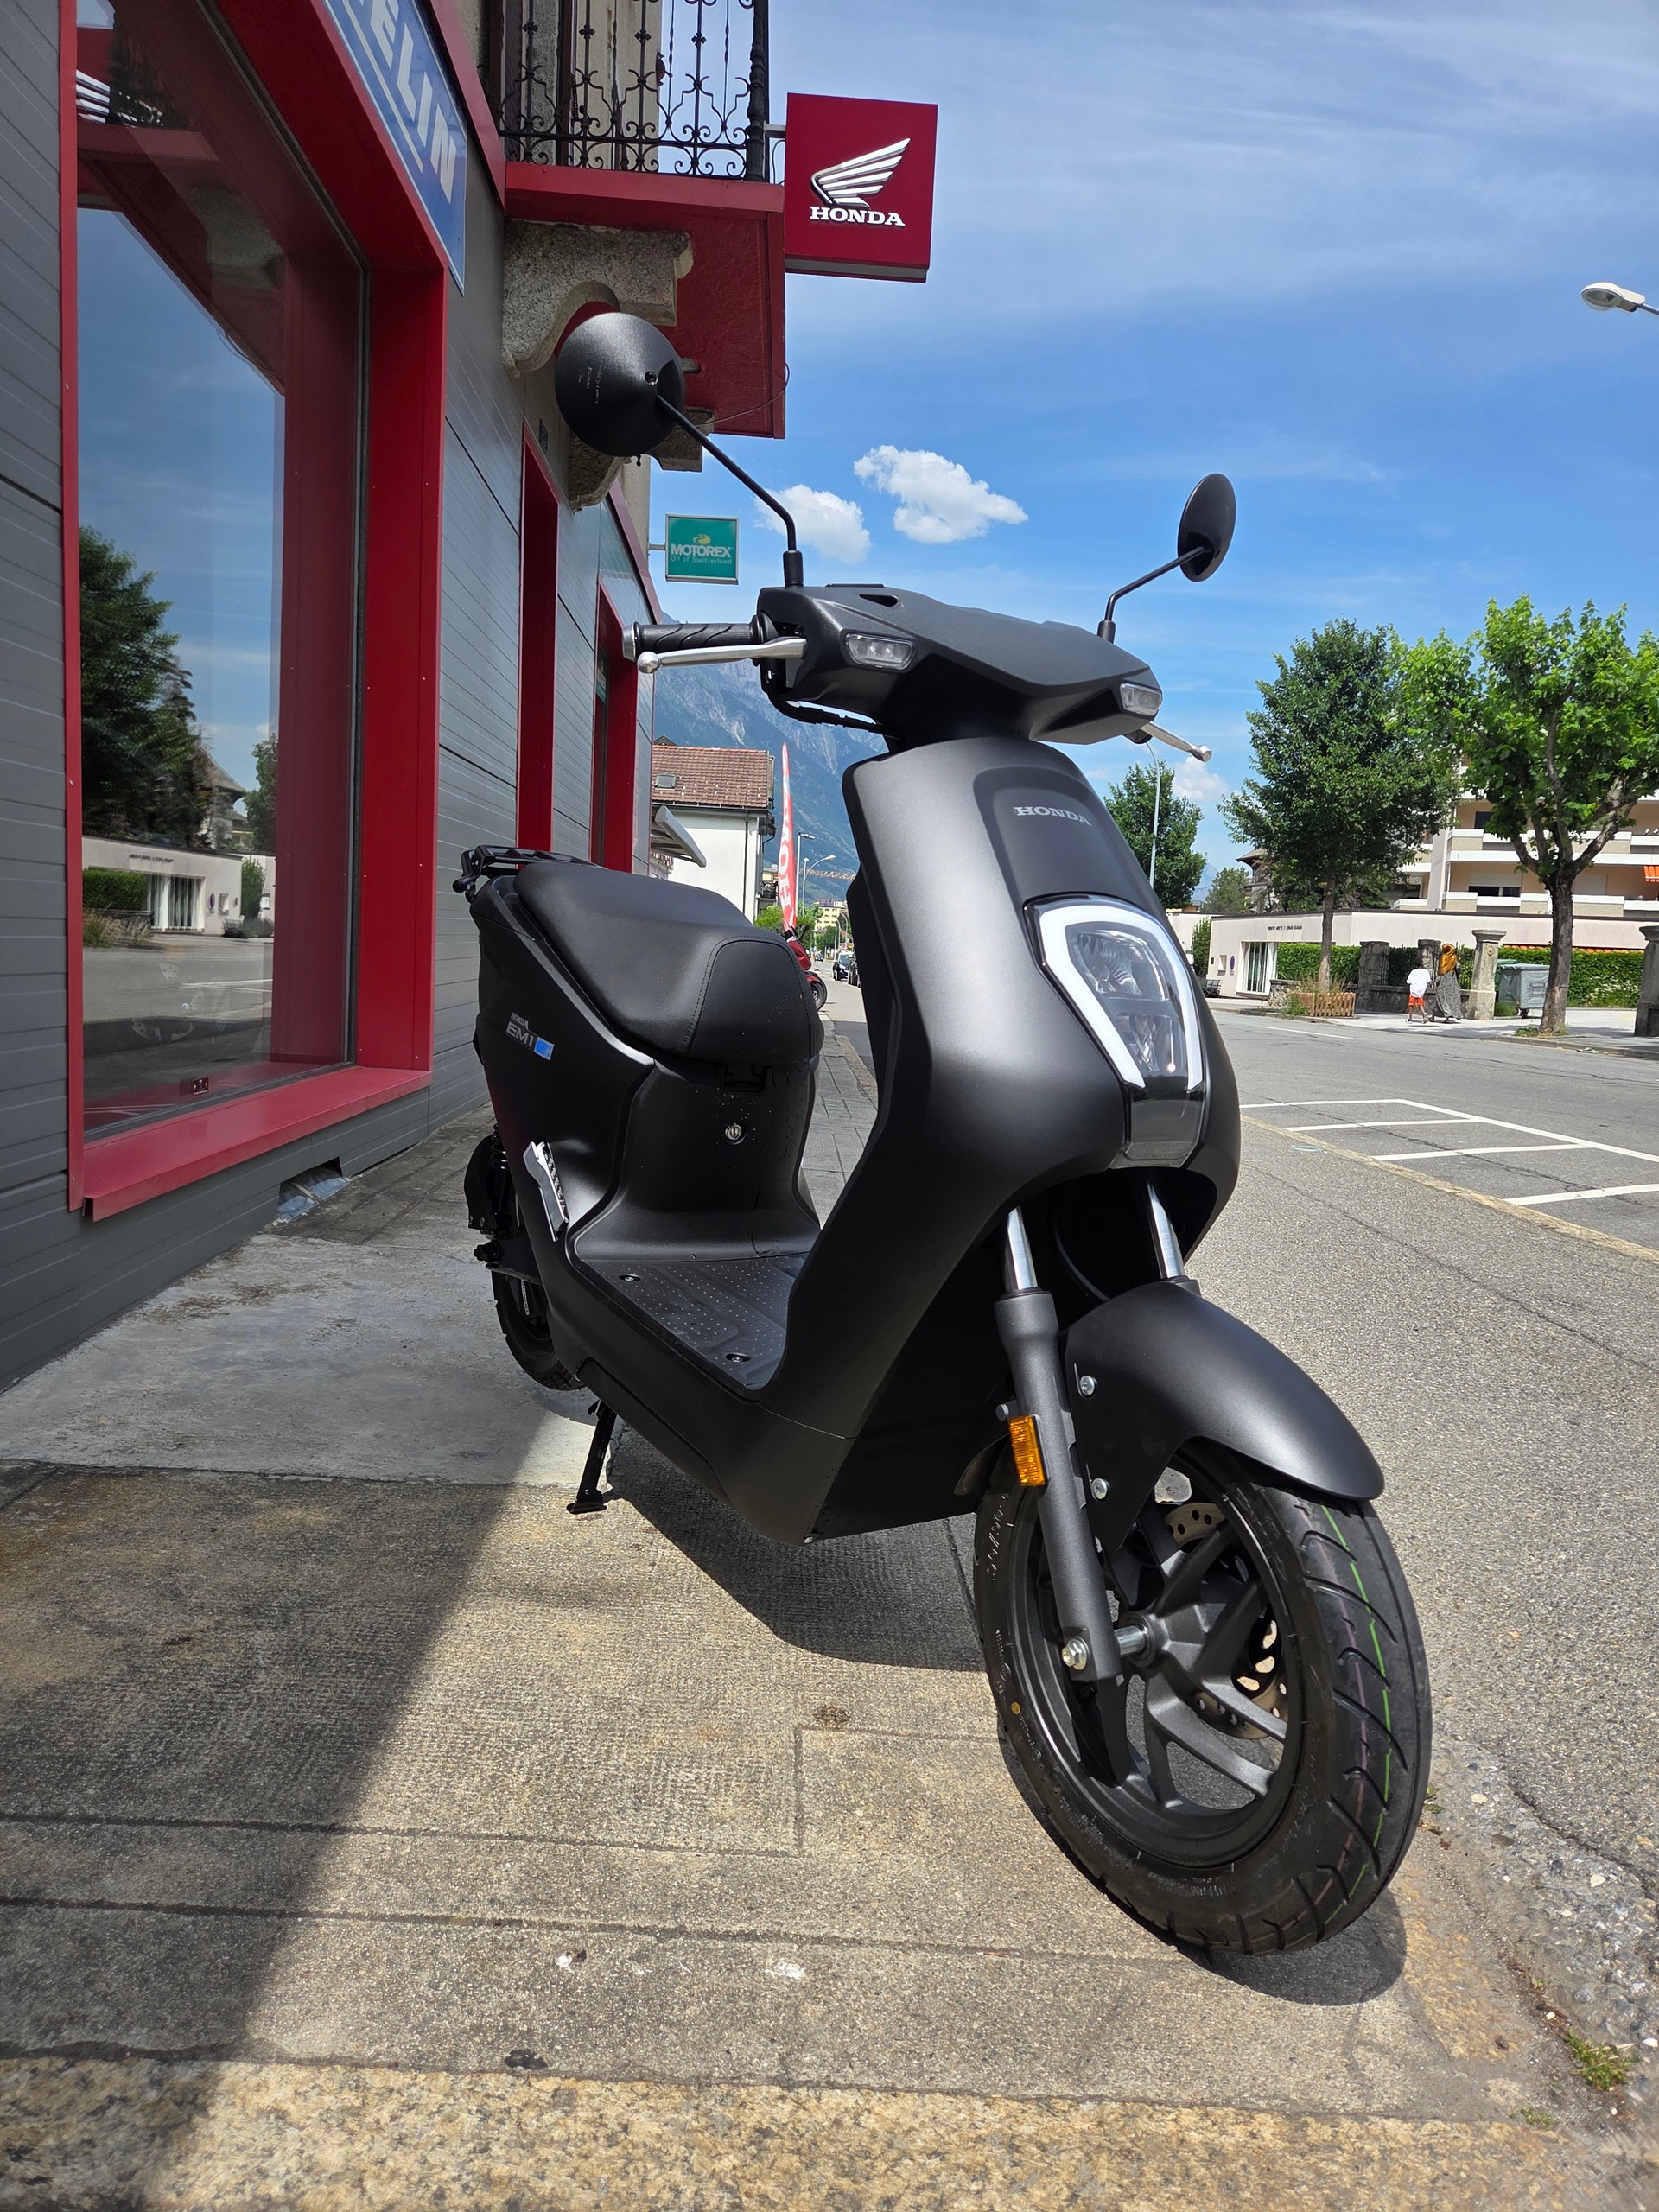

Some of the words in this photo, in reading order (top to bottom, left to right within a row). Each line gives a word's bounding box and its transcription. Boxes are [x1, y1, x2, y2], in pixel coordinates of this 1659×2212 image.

[359, 0, 456, 205] ELIN
[810, 206, 906, 226] HONDA
[671, 543, 732, 558] MOTOREX
[691, 556, 732, 565] Switzerland
[1014, 806, 1092, 827] HONDA
[505, 1021, 535, 1047] EM1
